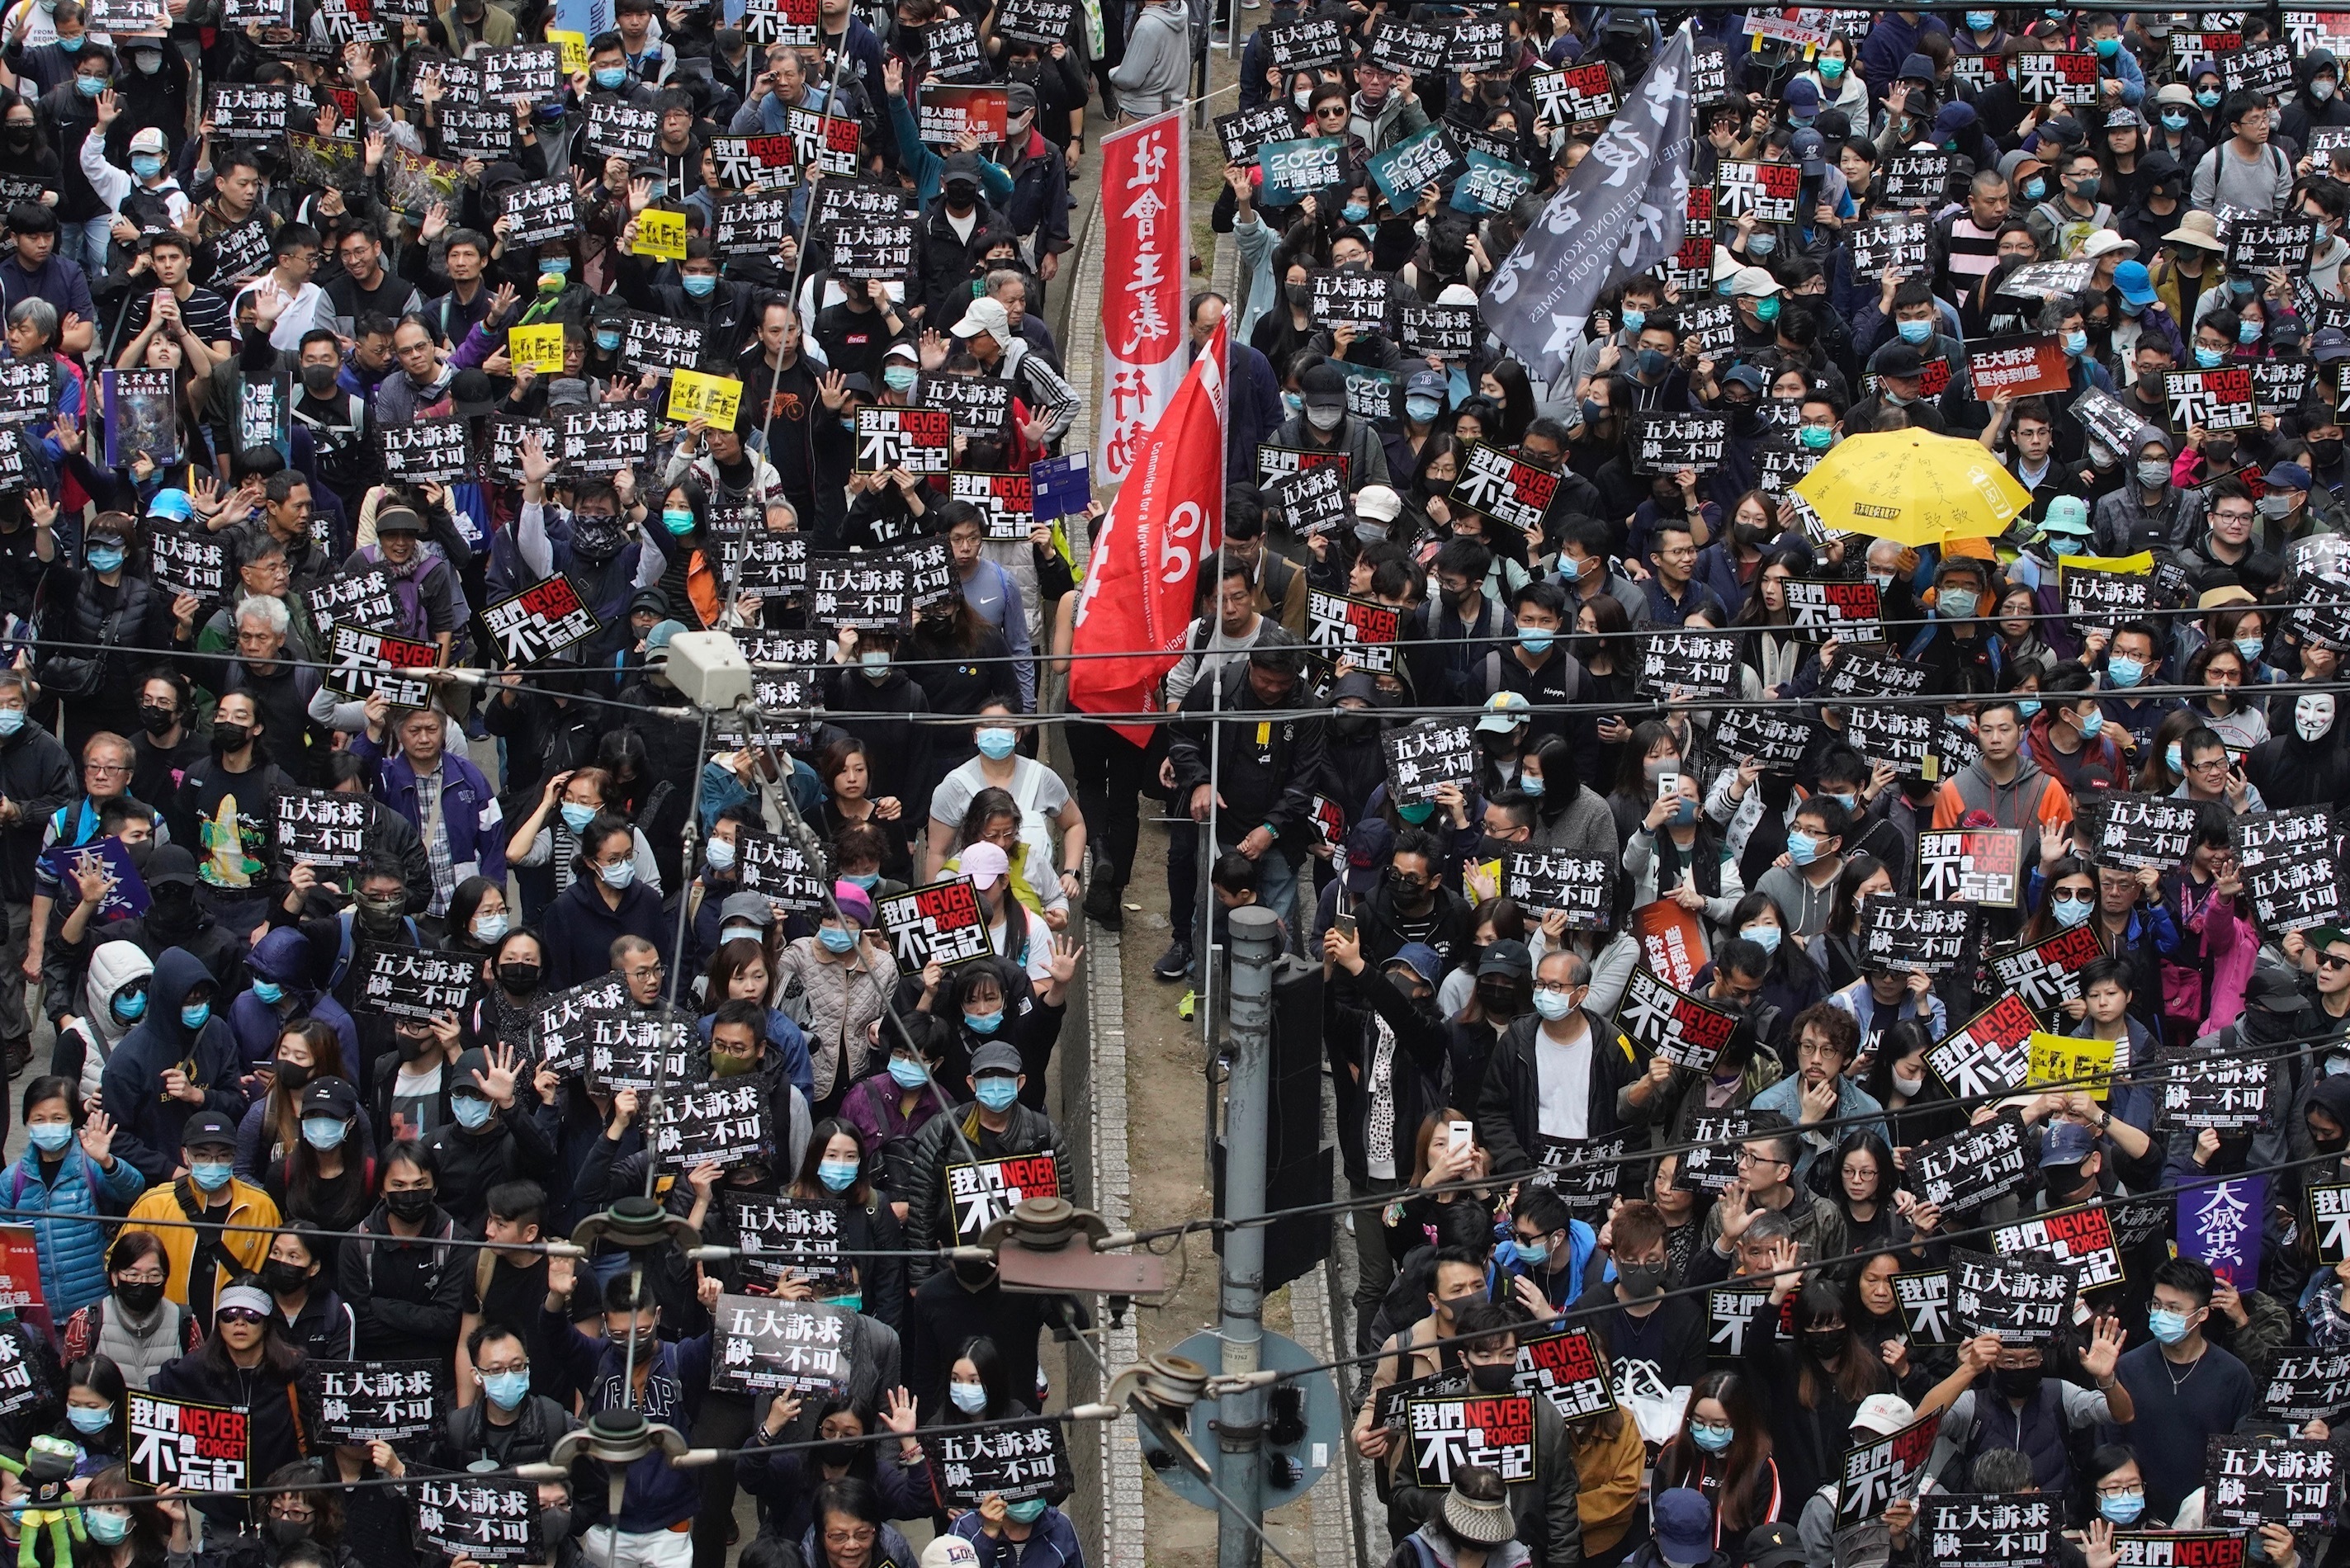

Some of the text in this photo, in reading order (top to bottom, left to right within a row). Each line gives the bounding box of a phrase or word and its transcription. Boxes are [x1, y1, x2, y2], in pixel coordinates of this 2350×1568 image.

[1270, 21, 1337, 45] 五大訴求
[485, 51, 555, 72] 五大訴求
[1274, 36, 1342, 63] 缺一不可
[2223, 44, 2288, 74] 五大訴求
[2021, 54, 2096, 73] 我們 NEVER
[2066, 71, 2095, 83] FORGET
[2225, 60, 2292, 92] 缺一不可
[485, 69, 555, 92] 缺一不可
[215, 91, 286, 109] 五大訴求
[2056, 84, 2095, 105] 忘記
[215, 109, 286, 126] 缺一不可
[589, 102, 658, 129] 五大訴求
[588, 120, 655, 149] 缺一不可
[1271, 149, 1338, 171] 2020
[1382, 134, 1442, 177] 2020
[1721, 162, 1798, 184] 我們 NEVER
[1767, 184, 1795, 197] FORGET
[720, 200, 783, 223] 五大訴求
[1754, 198, 1795, 220] 忘記
[717, 220, 783, 243] 缺一不可
[835, 226, 911, 246] 五大訴求
[1852, 224, 1926, 248] 五大訴求
[834, 247, 910, 264] 缺一不可
[1854, 243, 1926, 268] 缺一不可
[1313, 276, 1386, 296] 五大訴求
[1313, 296, 1385, 319] 缺一不可
[627, 320, 702, 347] 五大訴求
[625, 338, 699, 368] 缺一不可
[1972, 347, 2036, 369] 五大訴求
[1977, 365, 2041, 387] 堅持到底
[2167, 371, 2249, 393] 我們 NEVER
[2217, 388, 2251, 404] FORGET
[565, 409, 647, 436] 五大訴求
[860, 411, 948, 432] 我們 NEVER
[1643, 420, 1725, 440] 五大訴求
[2206, 404, 2254, 430] 忘記
[565, 432, 647, 459] 缺一不可
[914, 433, 948, 446] FORGET
[1642, 442, 1723, 460] 缺一不可
[900, 448, 948, 472] 忘記
[1141, 442, 1163, 495] Committee
[1471, 446, 1557, 494] 我們 NEVER
[1139, 496, 1151, 512] for
[1515, 487, 1549, 509] FORGET
[1490, 498, 1543, 528] 忘記
[152, 531, 222, 565] 五大訴求
[1137, 523, 1149, 568] Workers
[154, 554, 223, 588] 缺一不可
[816, 569, 904, 592] 五大訴求
[485, 578, 572, 633] 我們 NEVER
[544, 595, 578, 622] FORGET
[816, 593, 902, 616] 缺一不可
[540, 613, 596, 650] 忘記
[1648, 635, 1733, 660] 五大訴求
[1644, 654, 1732, 683] 缺一不可
[1848, 706, 1930, 737] 五大訴求
[1848, 727, 1929, 758] 缺一不可
[278, 796, 363, 825] 五大訴求
[2110, 800, 2196, 830] 五大訴求
[279, 822, 363, 852] 缺一不可
[2102, 824, 2191, 857] 缺一不可
[1512, 852, 1605, 882] 五大訴求
[2250, 861, 2333, 899] 五大訴求
[881, 884, 972, 926] 我們 NEVER
[1510, 875, 1601, 908] 缺一不可
[2256, 883, 2337, 923] 缺一不可
[937, 908, 977, 933] FORGET
[1875, 906, 1966, 933] 五大訴求
[927, 924, 988, 962] 忘記
[1870, 929, 1964, 958] 缺一不可
[375, 952, 474, 984] 五大訴求
[367, 974, 470, 1009] 缺一不可
[2168, 1057, 2267, 1084] 五大訴求
[2164, 1088, 2267, 1110] 缺一不可
[1916, 1122, 2018, 1182] 五大訴求
[1926, 1152, 2024, 1206] 缺一不可
[730, 1309, 843, 1344] 五大訴求
[726, 1339, 840, 1374] 缺一不可
[322, 1372, 433, 1396] 五大訴求
[130, 1399, 244, 1439] 我們 NEVER
[323, 1398, 432, 1422] 缺一不可
[1411, 1400, 1530, 1430] 我們 NEVER
[939, 1429, 1052, 1462] 五大訴求
[1486, 1425, 1531, 1446] FORGET
[196, 1440, 244, 1459] FORGET
[2220, 1448, 2333, 1478] 五大訴求
[179, 1457, 244, 1491] 忘記
[945, 1454, 1055, 1487] 缺一不可
[418, 1481, 528, 1516] 五大訴求
[419, 1505, 529, 1543] 缺一不可
[1933, 1504, 2049, 1531] 五大訴求
[1933, 1531, 2049, 1557] 缺一不可
